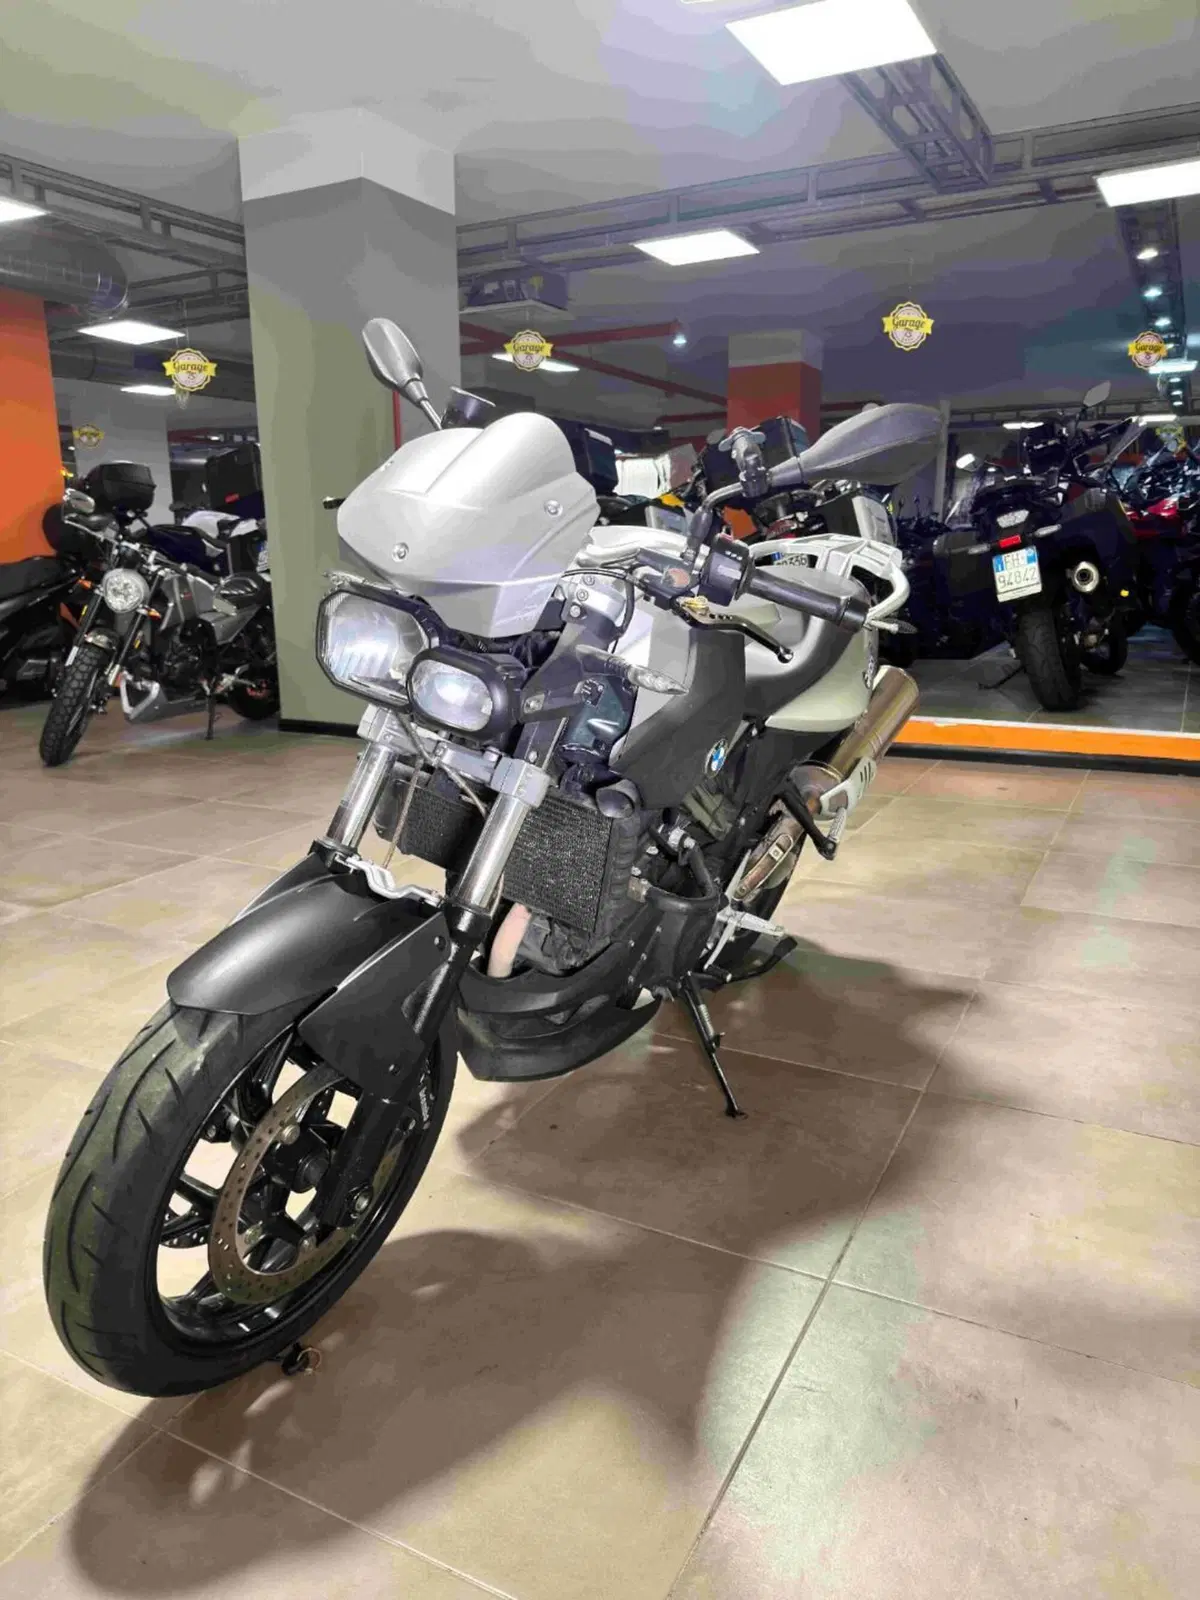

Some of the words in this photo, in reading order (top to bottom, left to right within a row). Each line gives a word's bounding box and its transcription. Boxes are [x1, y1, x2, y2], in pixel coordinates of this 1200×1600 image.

[892, 317, 926, 330] Garage
[173, 361, 208, 373] Garage
[998, 567, 1037, 589] 94842
